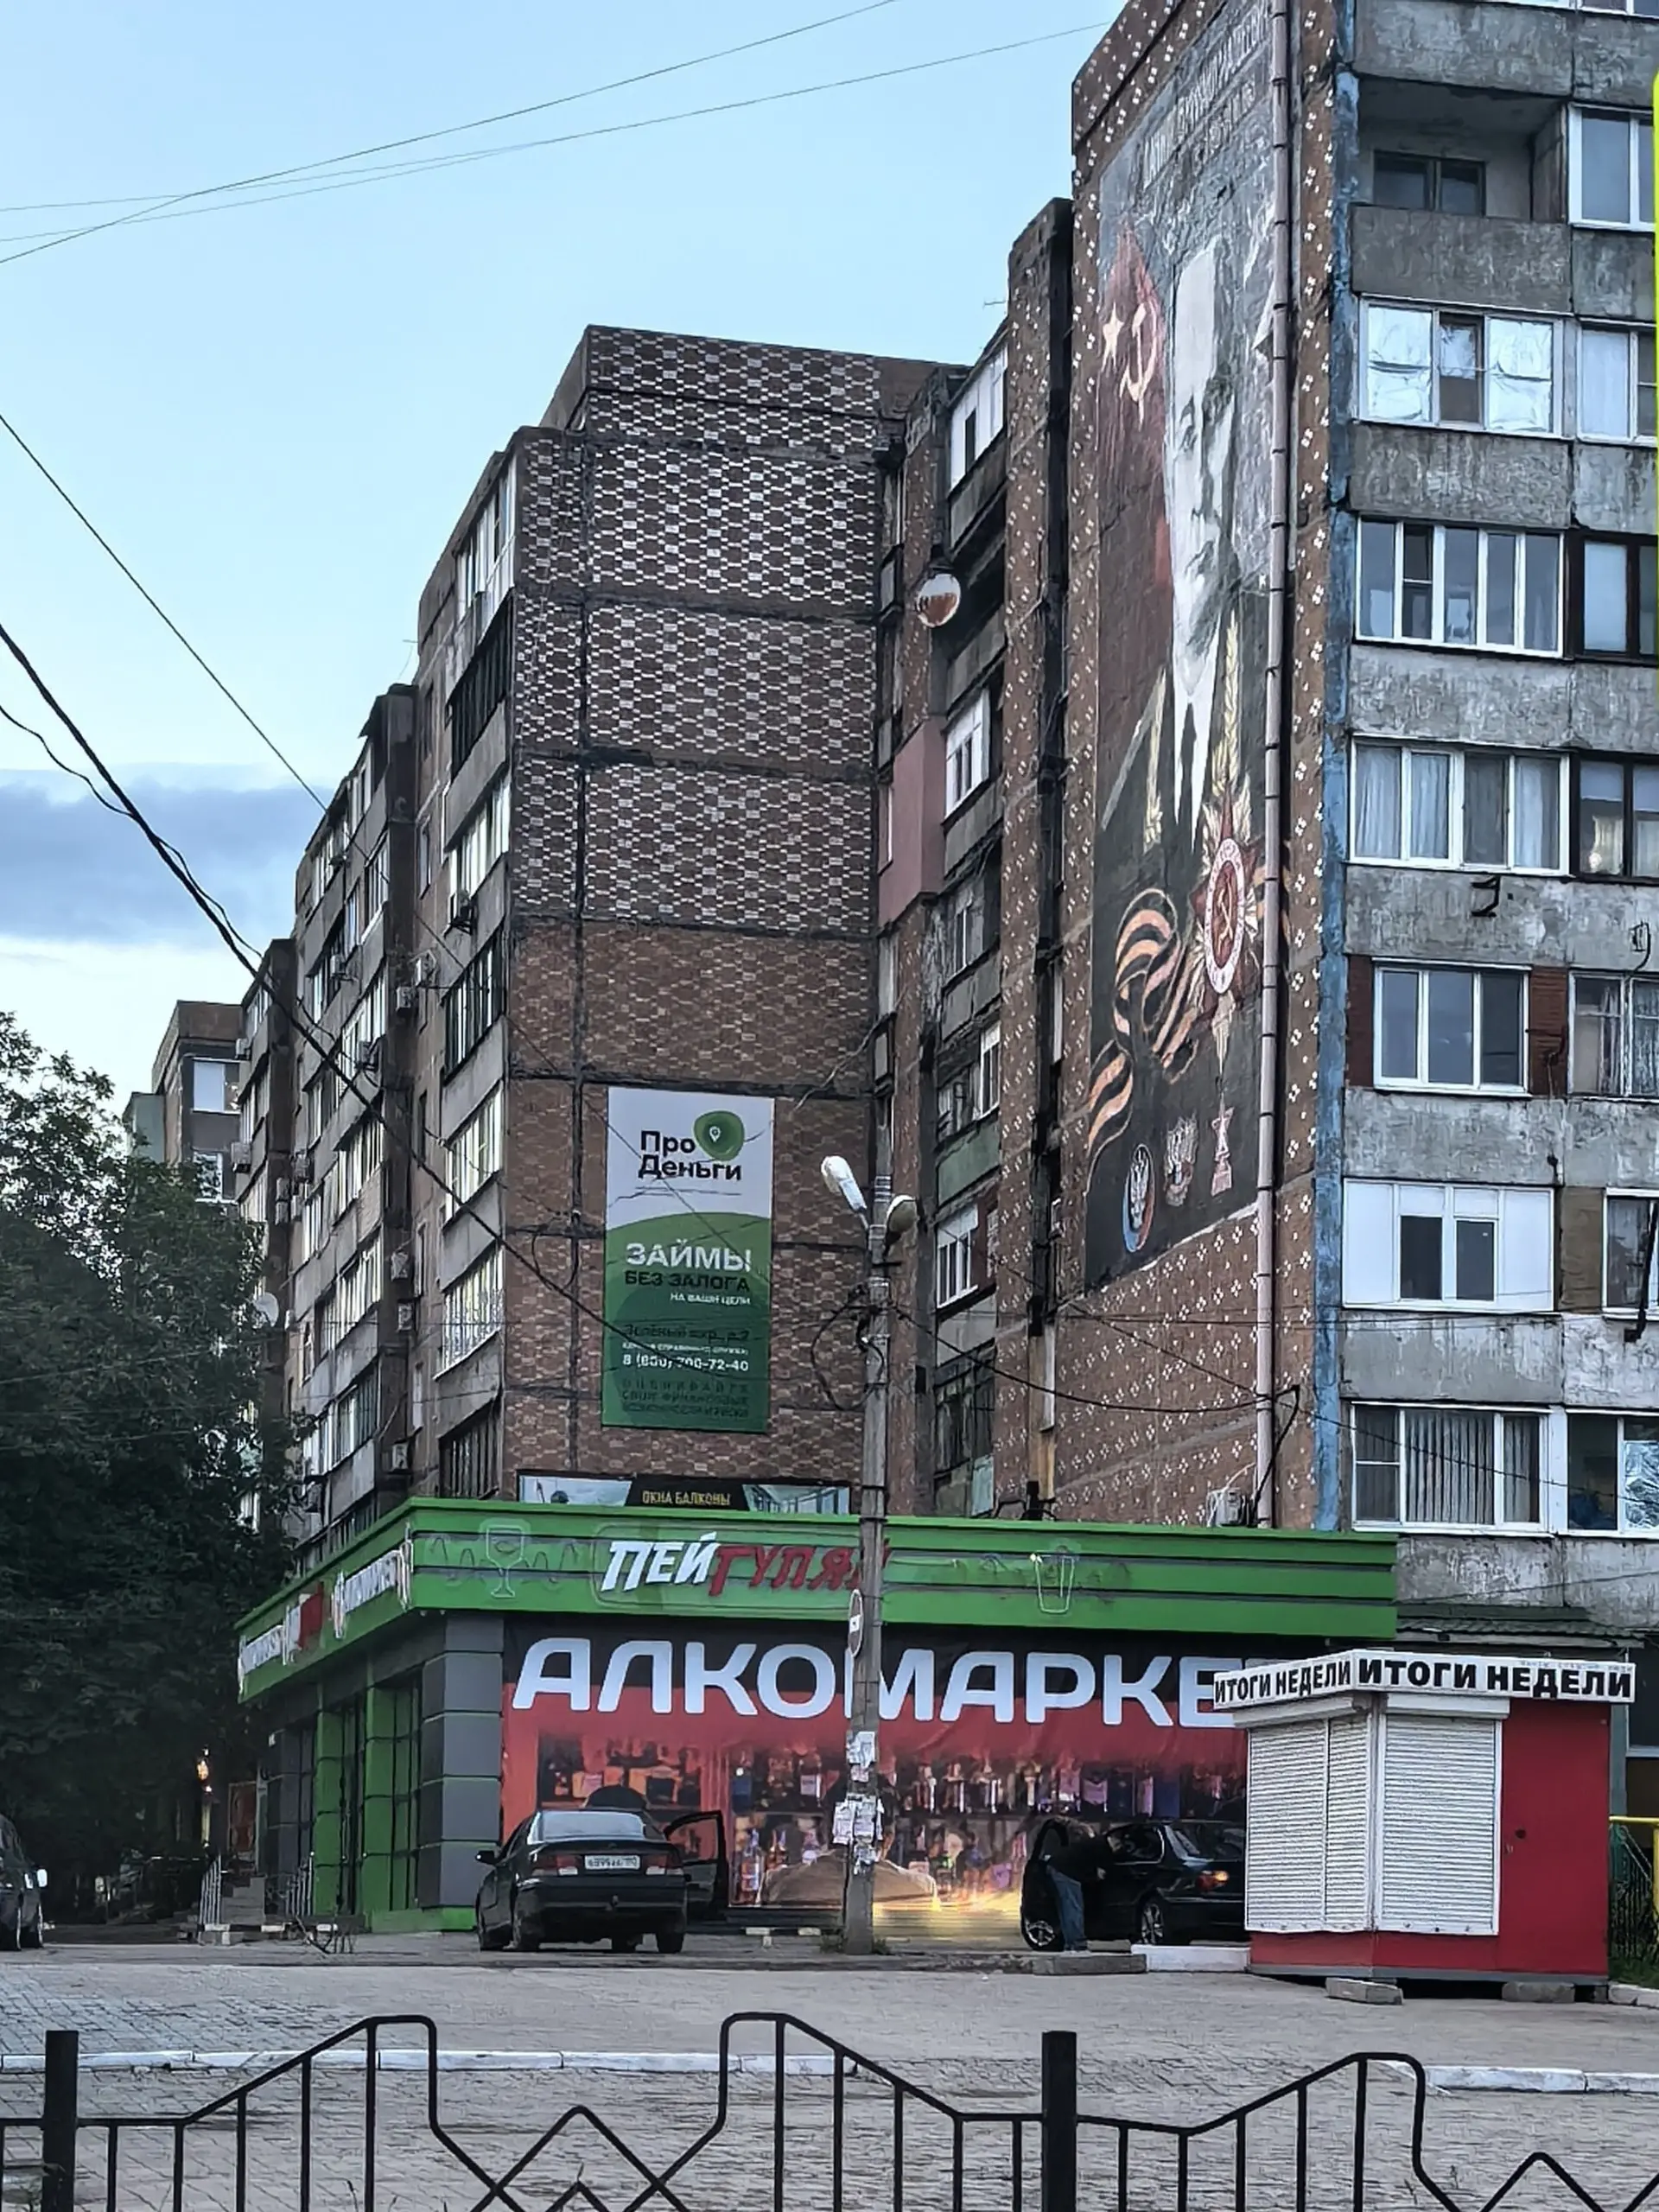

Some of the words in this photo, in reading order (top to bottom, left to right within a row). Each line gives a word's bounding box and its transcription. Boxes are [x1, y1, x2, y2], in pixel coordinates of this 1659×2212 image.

[641, 1130, 696, 1157] Про
[638, 1154, 741, 1180] Деньги
[626, 1239, 751, 1272] ЗАЙМЫ
[625, 1270, 663, 1287] БЕЗ
[668, 1273, 750, 1293] ЗАЛОГА
[671, 1293, 684, 1301] НА
[623, 1354, 631, 1365] 8
[642, 1490, 672, 1504] ОКНА
[675, 1491, 730, 1505] БАЛКОНЫ
[601, 1531, 720, 1592] ПЕЙ
[512, 1637, 1291, 1727] АЛКОМАРКЕ
[1215, 1673, 1270, 1703] ИТОГИ
[1276, 1661, 1351, 1696] НЕДЕЛИ
[1359, 1658, 1477, 1688] ИТОГИ
[1487, 1665, 1630, 1698] НЕДЕЛИ
